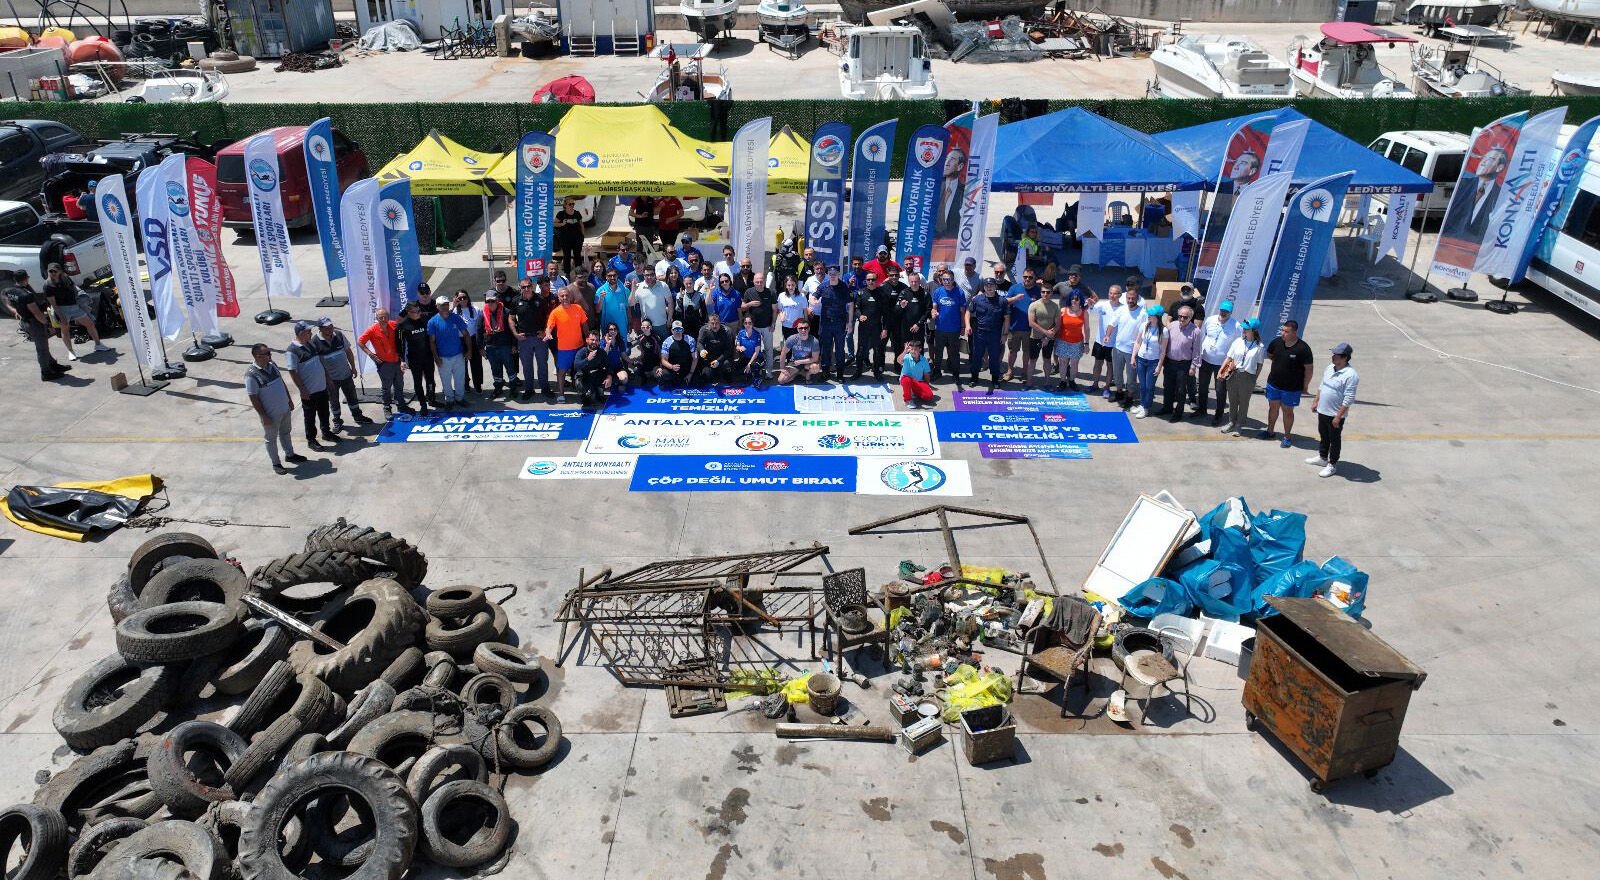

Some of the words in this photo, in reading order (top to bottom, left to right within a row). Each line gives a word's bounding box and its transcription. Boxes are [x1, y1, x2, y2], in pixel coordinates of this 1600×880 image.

[191, 172, 208, 227] YUNUS
[522, 174, 533, 226] GÜVENLİK
[867, 168, 875, 204] BELEDİYESİ
[905, 168, 922, 221] GÜVENLİK
[1494, 146, 1537, 250] KONYAALTI
[262, 200, 276, 241] SPORLARI
[538, 182, 547, 250] KOMUTANLIĞI
[862, 206, 873, 250] BÜYÜKŞEHİR
[917, 177, 935, 248] KOMUTANLIĞI
[143, 216, 172, 280] VSD
[178, 226, 196, 272] SPORLARI
[268, 243, 283, 268] SUALTI
[273, 222, 288, 254] KULÜBÜ
[523, 228, 532, 256] SAHİL
[903, 222, 914, 252] SAHİL
[1226, 246, 1249, 302] ÜYÜKŞEHİR
[1243, 195, 1264, 245] BELEDİYESİ
[1294, 226, 1313, 271] BELEDİYESİ
[192, 247, 211, 285] KULÜBÜ
[390, 238, 404, 279] BELEDİYESİ
[528, 261, 542, 269] 112
[188, 271, 204, 303] SUALTI
[442, 415, 539, 424] ANTALYA
[670, 404, 740, 412] TEMİZLİK
[846, 418, 902, 427] TEMİZ
[986, 431, 1064, 440] TEMİZLİĞİ
[1032, 424, 1059, 432] DİP
[648, 475, 683, 485] ÇÖP
[686, 475, 737, 484] DEĞİL
